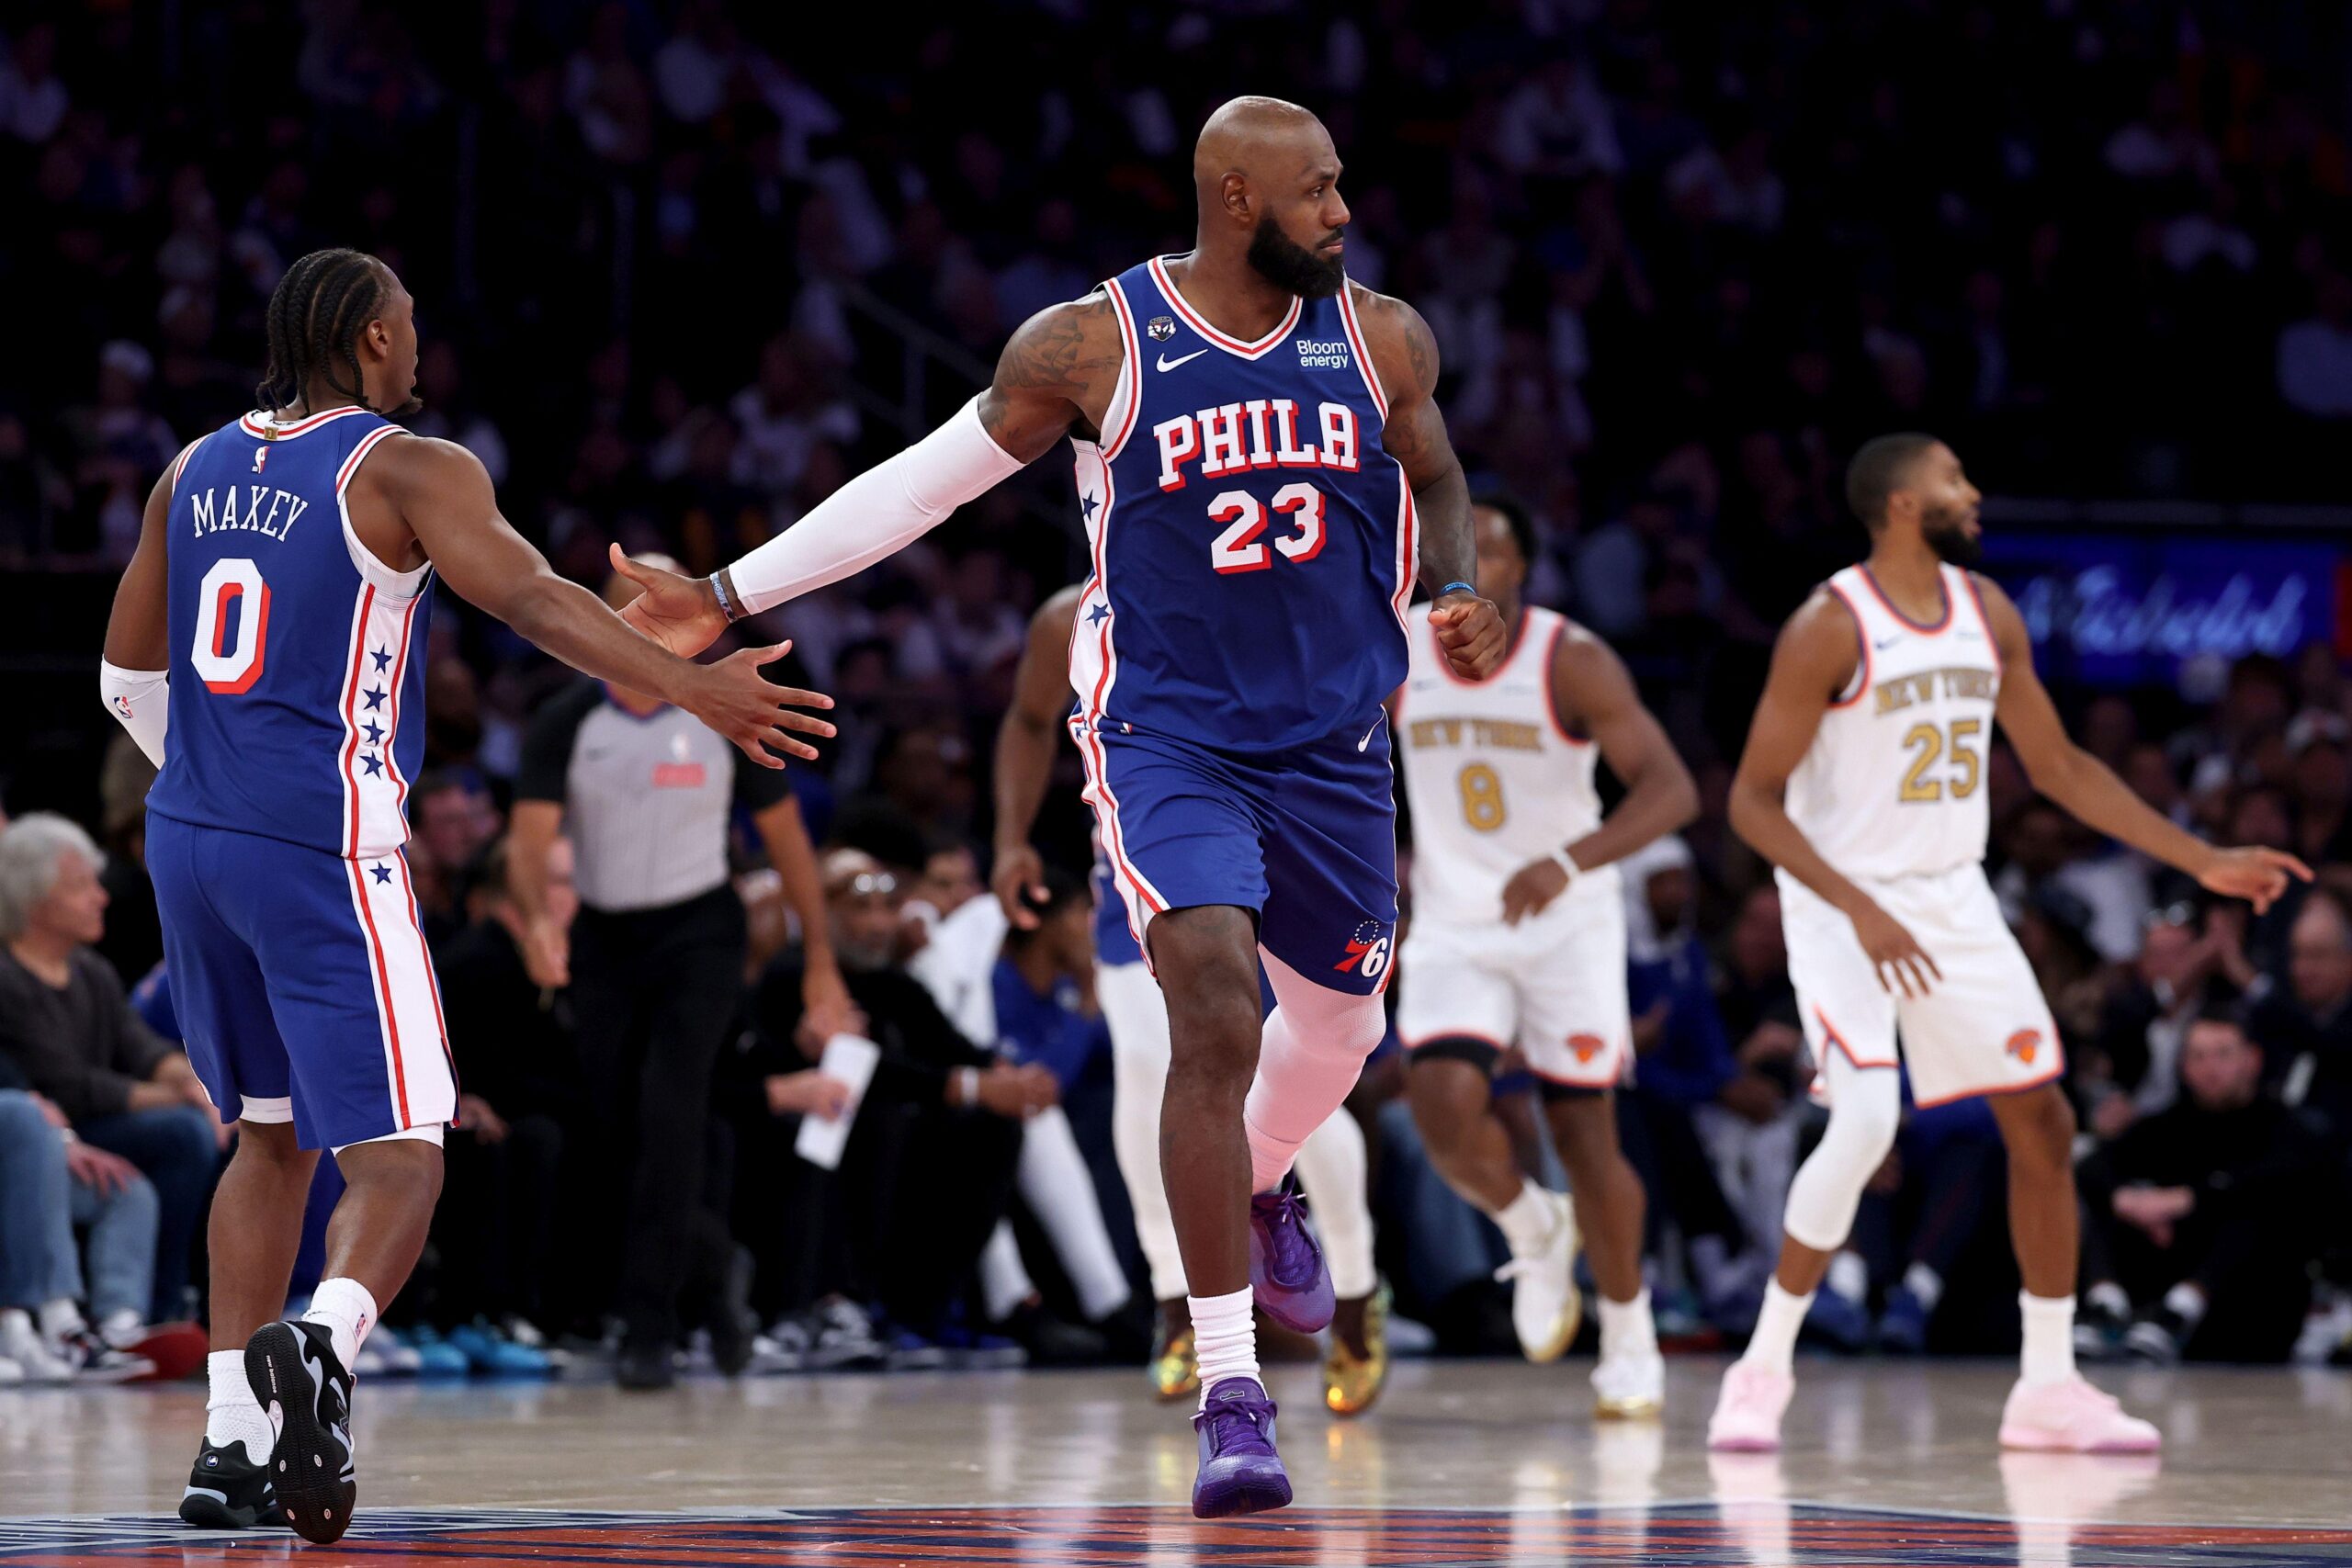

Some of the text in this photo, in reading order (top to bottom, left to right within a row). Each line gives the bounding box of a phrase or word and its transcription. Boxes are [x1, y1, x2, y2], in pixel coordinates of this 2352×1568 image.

[1296, 339, 1348, 355] Bloom
[1300, 355, 1349, 369] energy
[1153, 399, 1360, 492] PHILA
[191, 485, 309, 542] MAXEY
[1207, 482, 1327, 574] 23
[191, 558, 271, 694] 0
[1874, 671, 1933, 718] NEW
[1898, 718, 1981, 804] 25
[1459, 762, 1507, 832] 8
[1333, 937, 1388, 978] 76
[268, 1368, 277, 1394] balance
